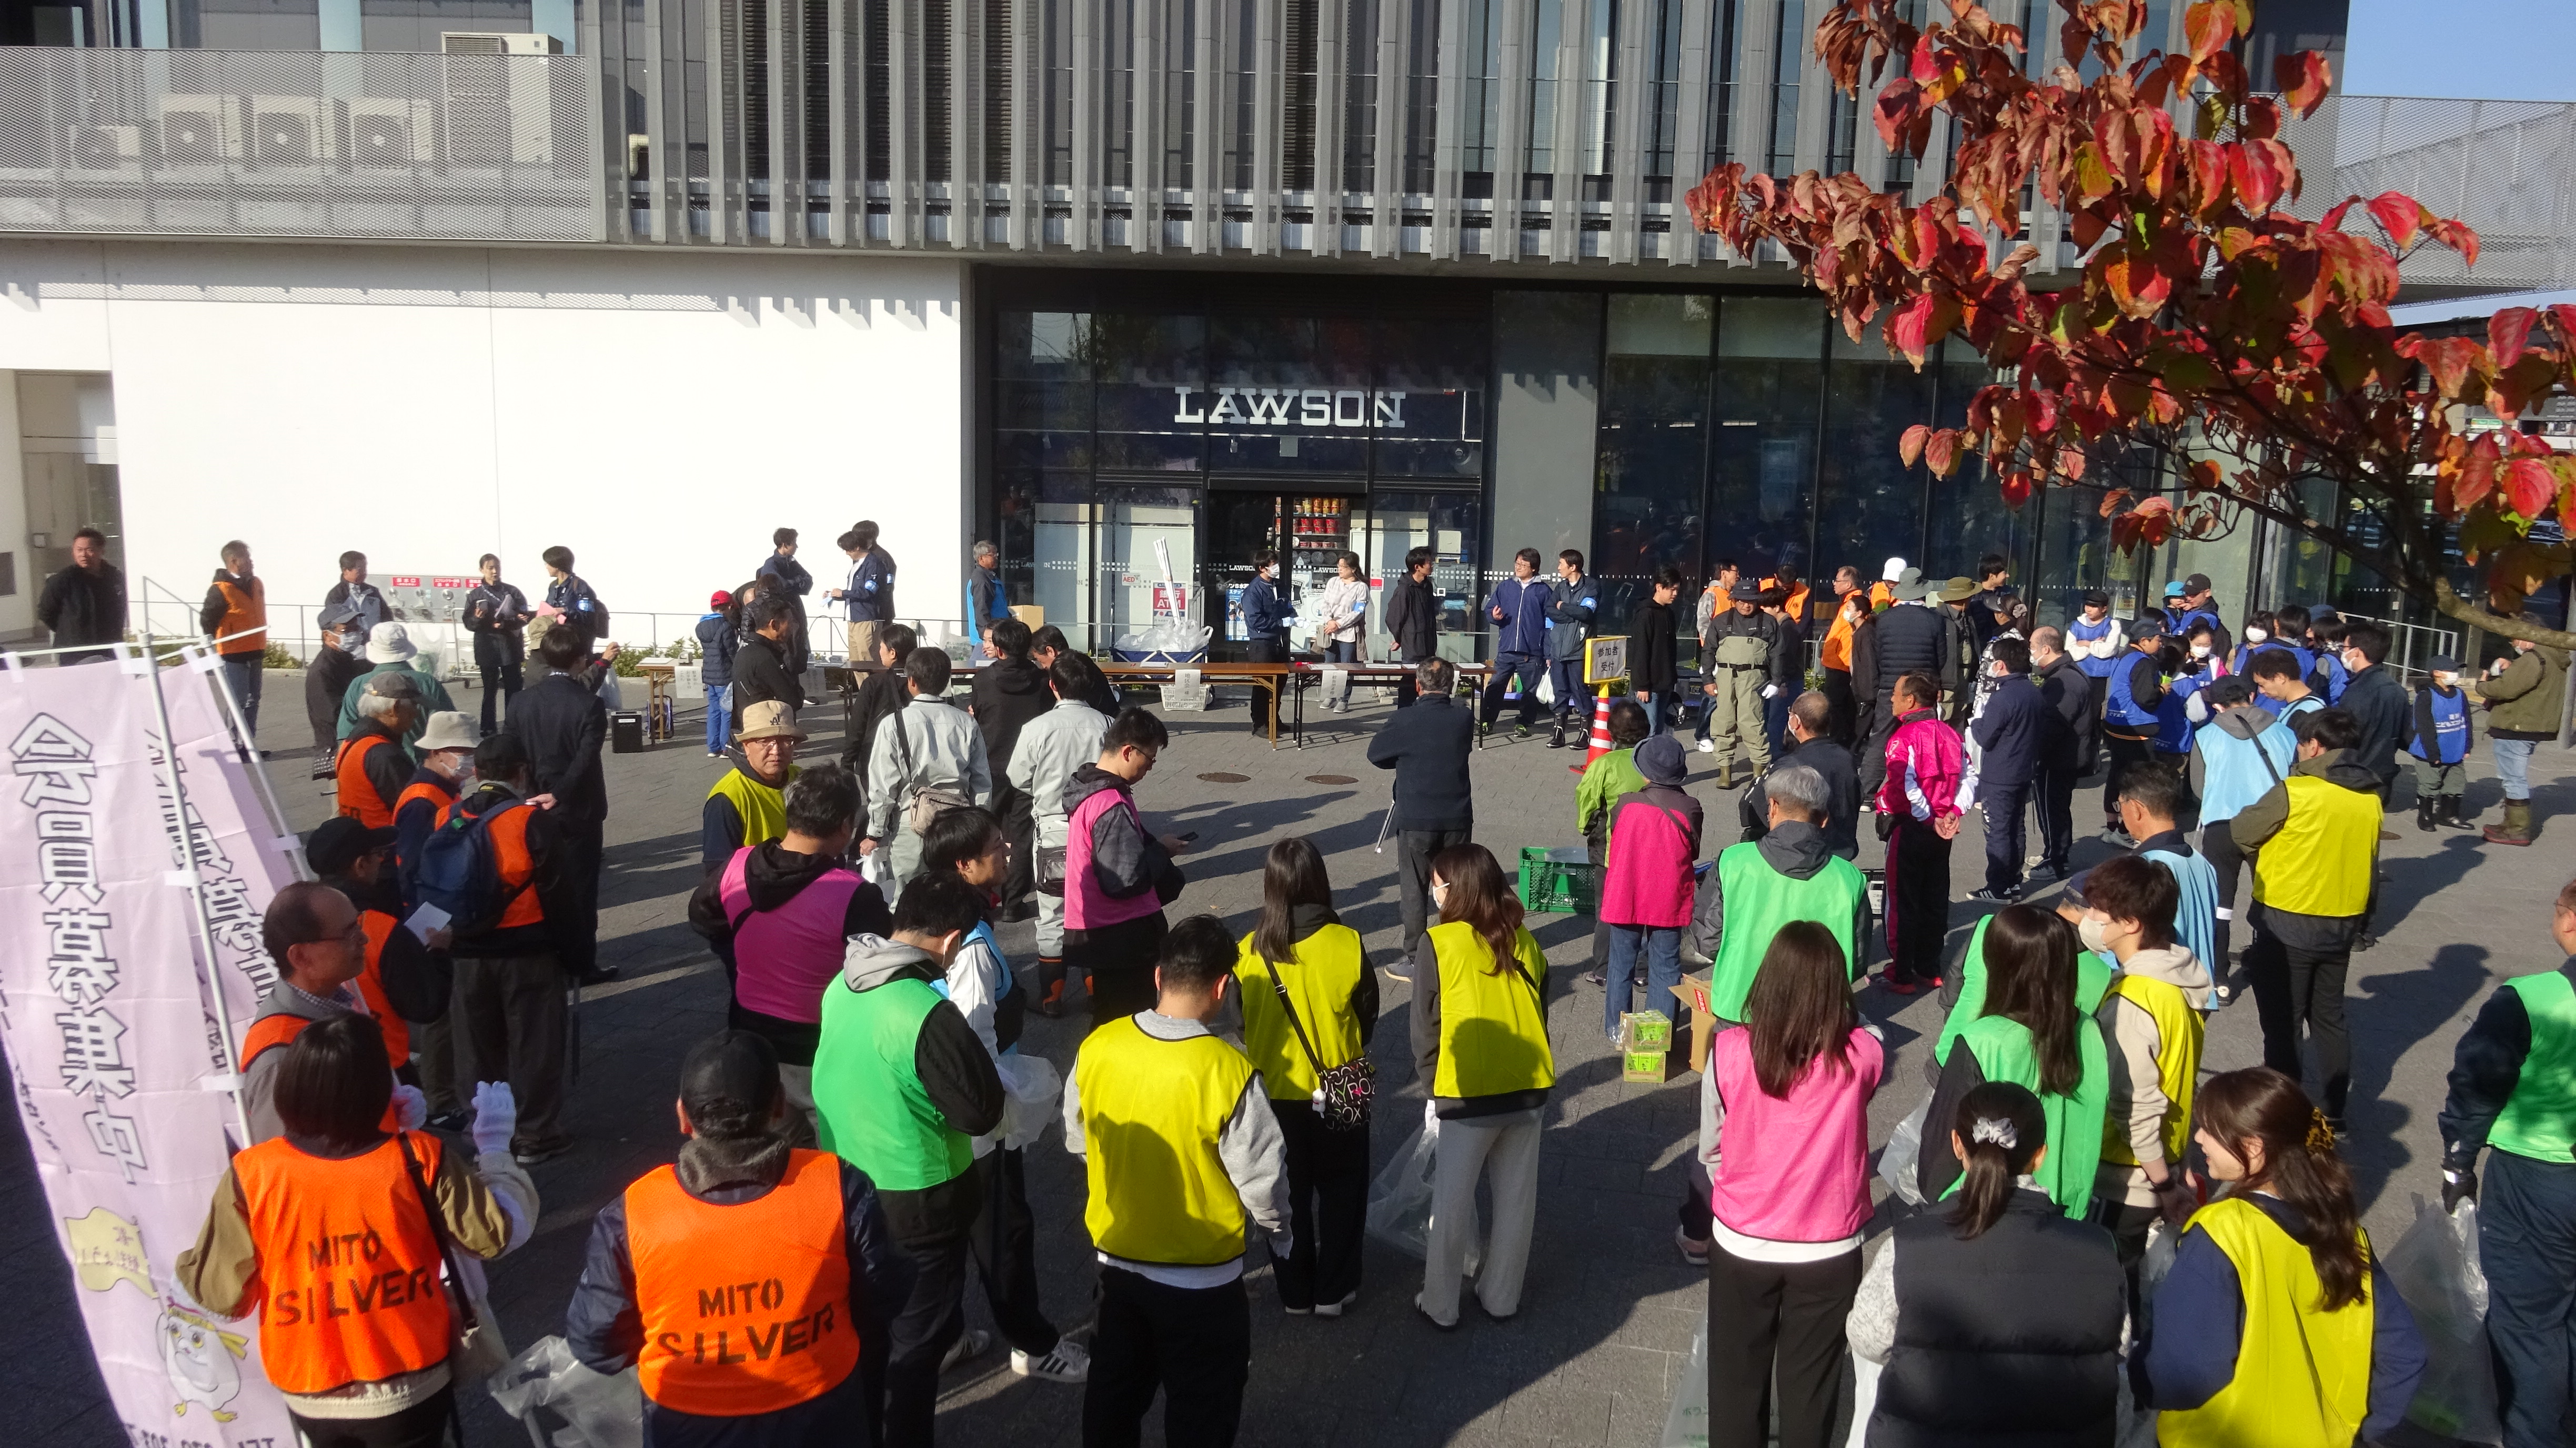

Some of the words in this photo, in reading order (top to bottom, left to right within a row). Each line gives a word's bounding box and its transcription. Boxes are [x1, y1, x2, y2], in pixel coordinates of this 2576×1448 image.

[1174, 387, 1406, 428] LAWSON
[1597, 645, 1618, 658] 参加者
[1601, 660, 1615, 672] 受付
[307, 1233, 383, 1272] MITO
[274, 1266, 434, 1328] SILVER
[698, 1278, 784, 1319] MITO
[657, 1303, 836, 1365] SILVER
